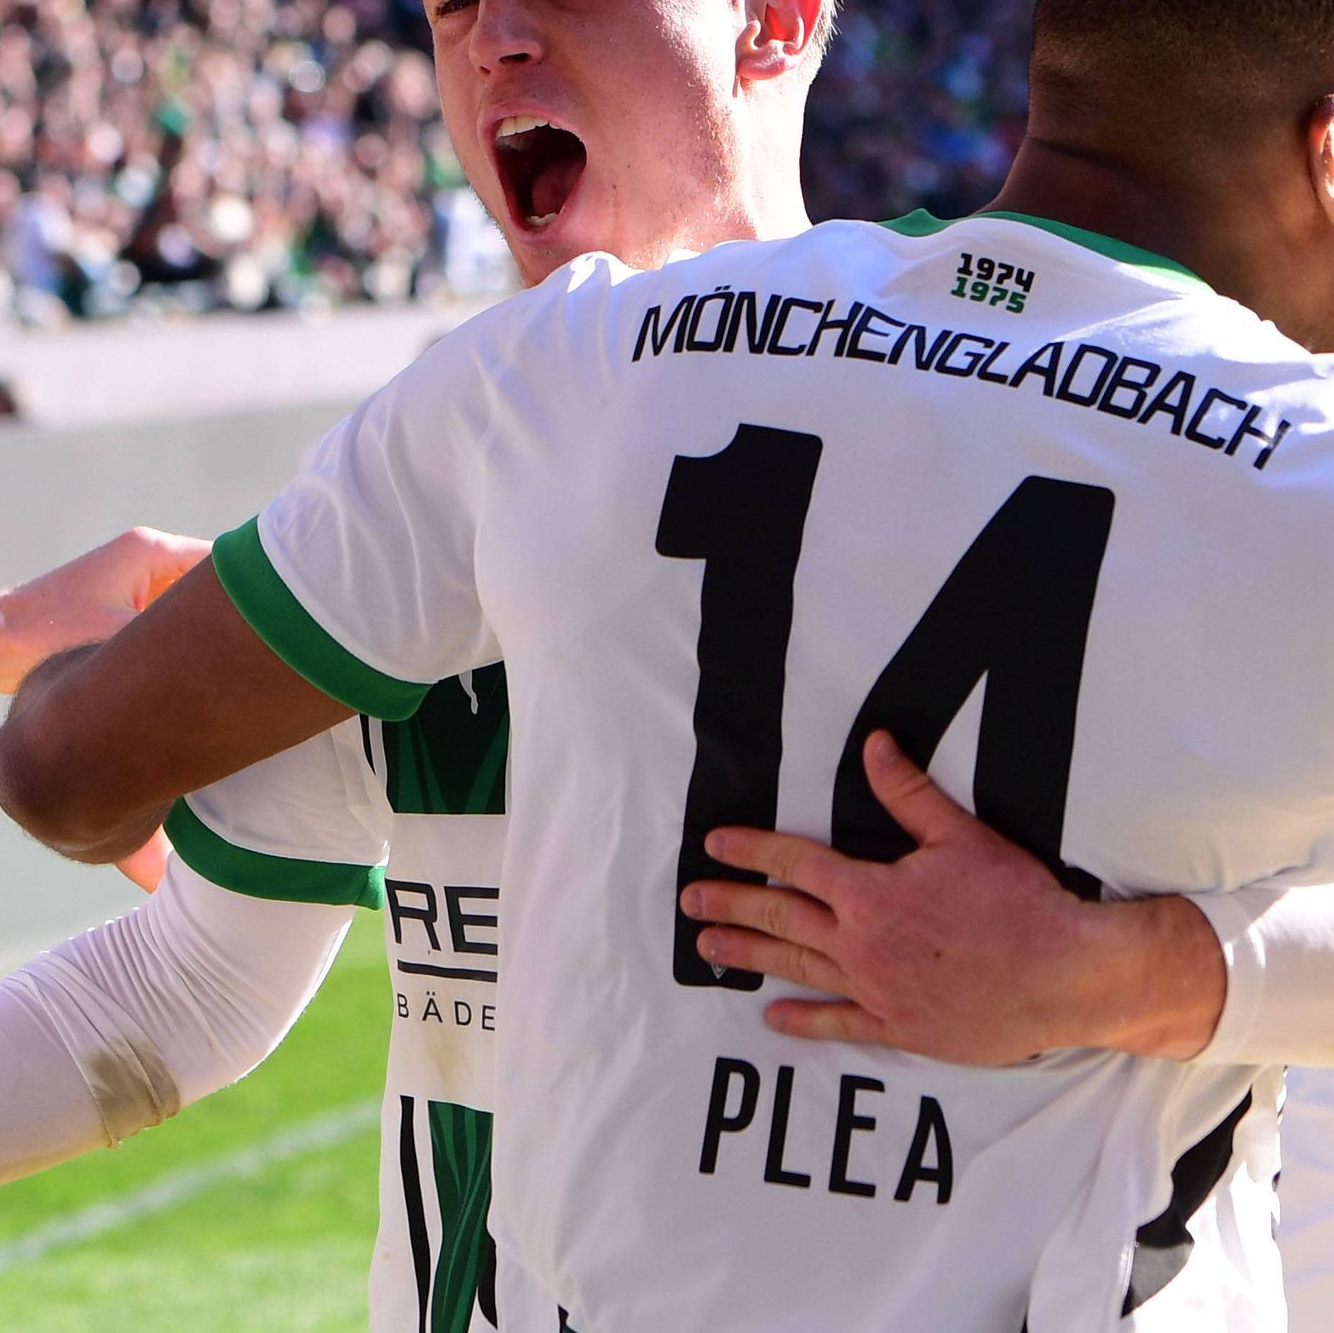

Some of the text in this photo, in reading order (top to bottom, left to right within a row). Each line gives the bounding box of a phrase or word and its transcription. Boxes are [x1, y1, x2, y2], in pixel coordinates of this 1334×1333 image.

[950, 276, 1027, 314] 1975
[956, 252, 1035, 293] 1974
[632, 285, 1292, 470] MÖNCHENGLADBACH
[655, 422, 1116, 992] 14
[396, 991, 496, 1032] BÄDE
[699, 1056, 954, 1205] PLEA
